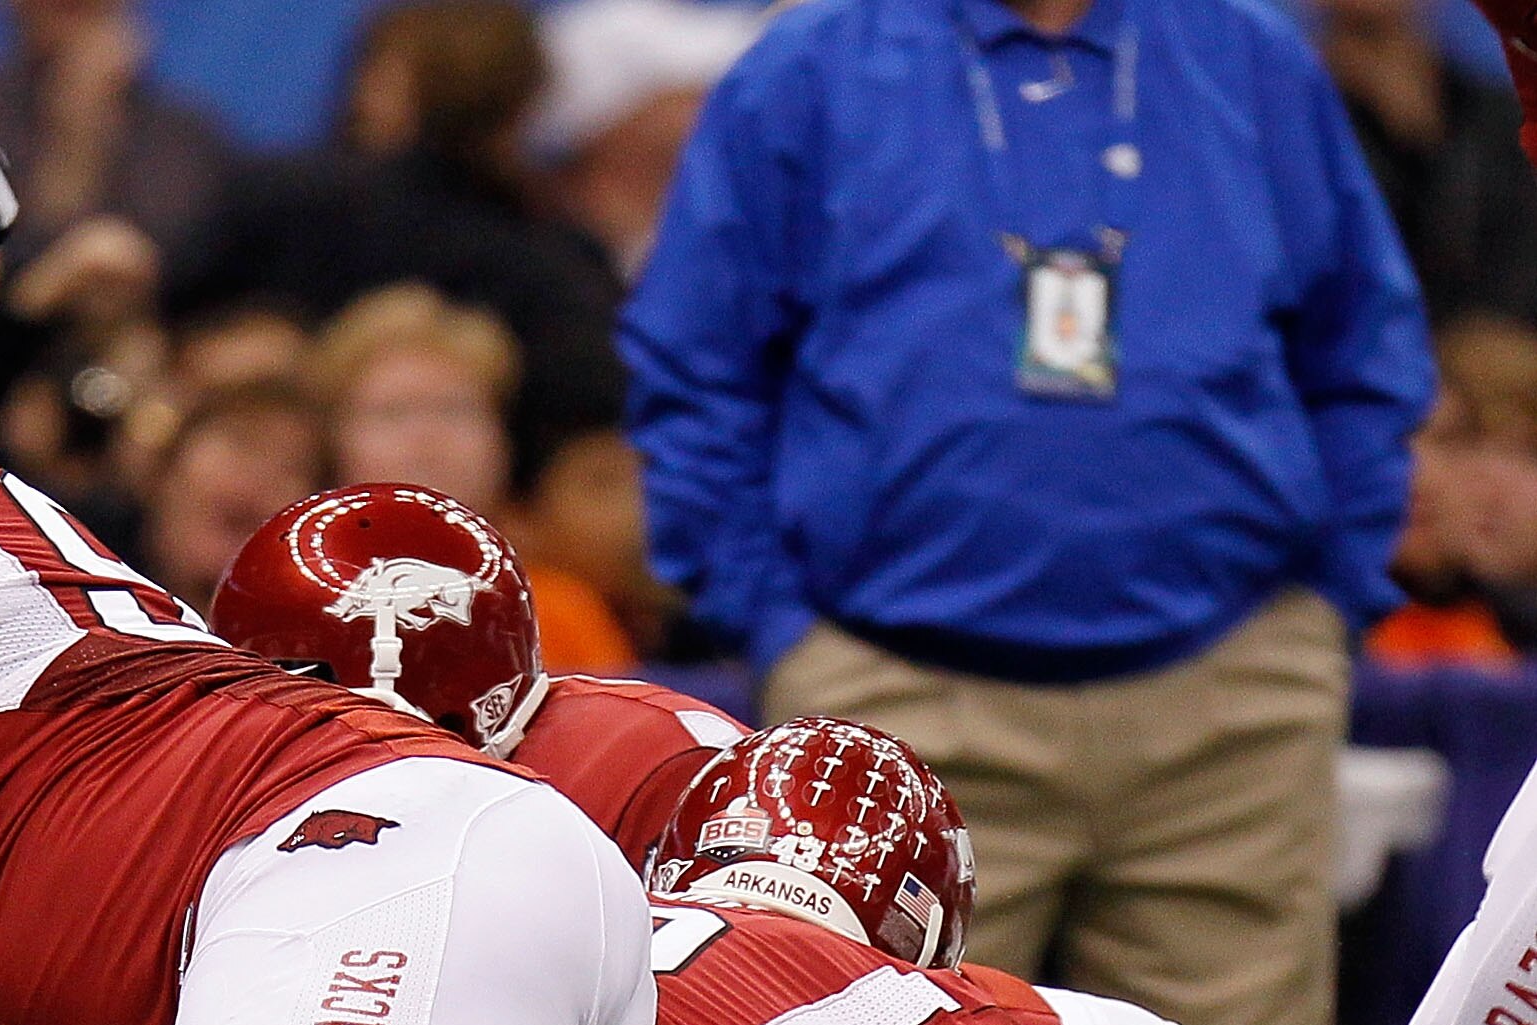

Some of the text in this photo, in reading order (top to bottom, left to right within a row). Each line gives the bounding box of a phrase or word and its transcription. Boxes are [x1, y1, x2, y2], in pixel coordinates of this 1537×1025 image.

[703, 816, 765, 842] BCS
[770, 834, 827, 873] 43
[723, 869, 833, 916] ARKANSAS
